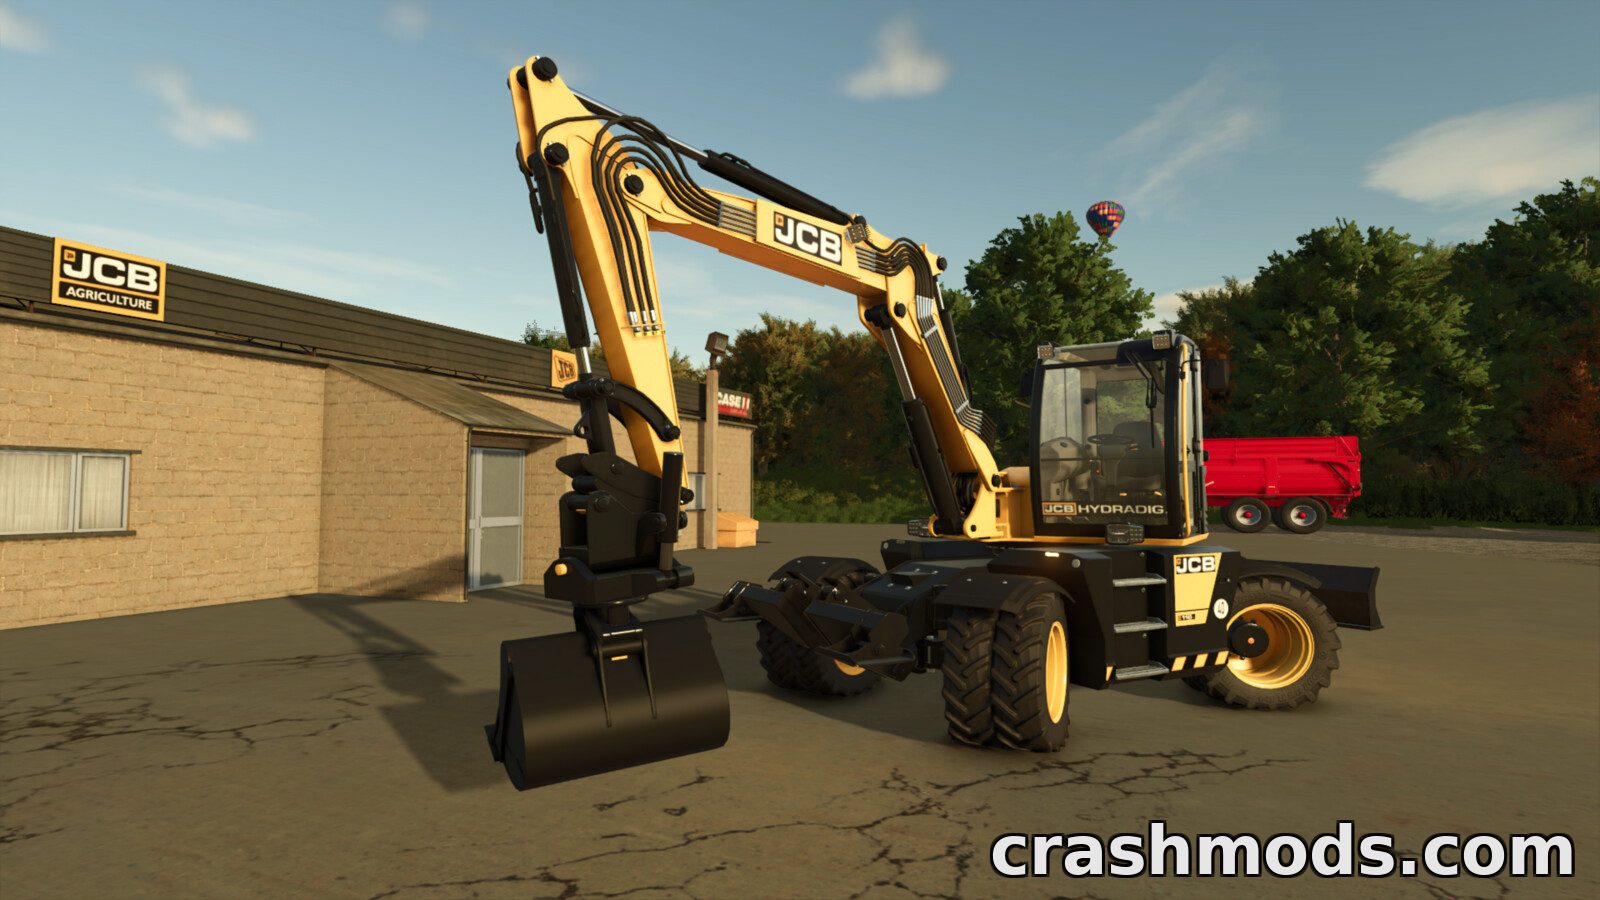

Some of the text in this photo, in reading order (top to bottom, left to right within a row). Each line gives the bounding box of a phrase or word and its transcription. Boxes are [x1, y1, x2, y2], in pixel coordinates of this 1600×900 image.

[775, 218, 841, 262] JCB
[63, 253, 158, 292] JCB
[66, 286, 153, 311] AGRICULTURE
[558, 360, 575, 379] JCB
[1044, 504, 1075, 514] JCB
[1176, 556, 1216, 574] JCB
